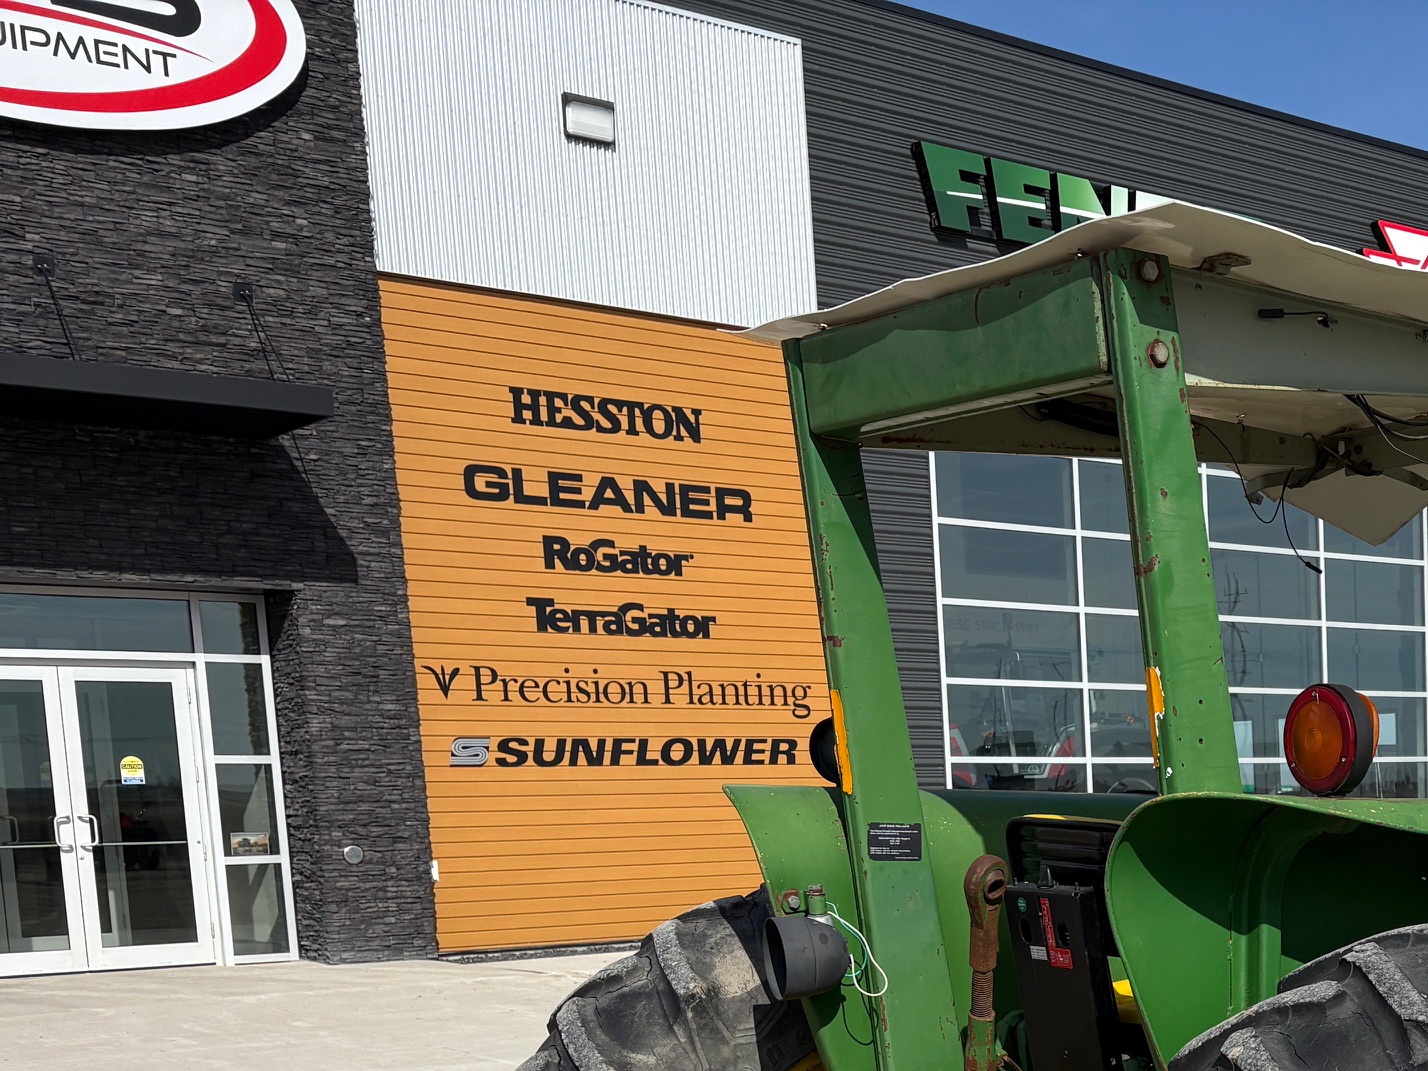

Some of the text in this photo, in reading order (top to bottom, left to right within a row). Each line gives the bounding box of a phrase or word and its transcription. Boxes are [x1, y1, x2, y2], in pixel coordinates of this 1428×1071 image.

[911, 141, 1178, 240] FEN
[508, 386, 702, 443] HESSTON
[463, 464, 753, 522] GLEANER
[542, 535, 693, 577] RoGator
[526, 597, 717, 639] TerraGator
[469, 665, 811, 719] Precision Planting
[495, 737, 798, 767] SUNFLOWER
